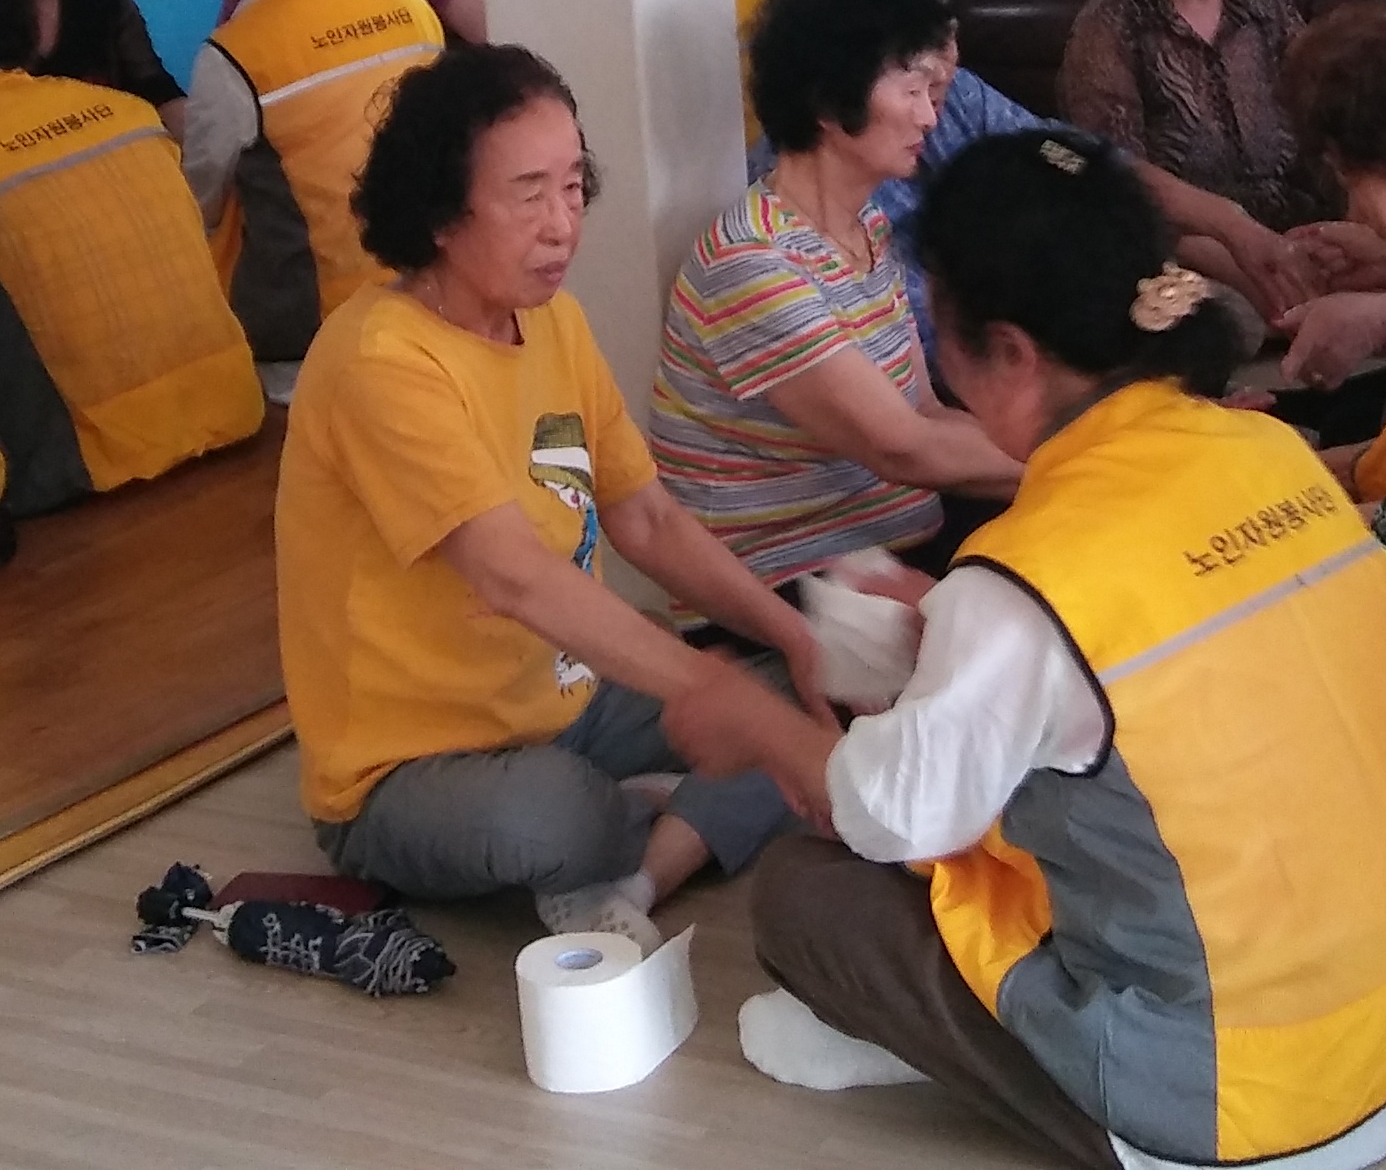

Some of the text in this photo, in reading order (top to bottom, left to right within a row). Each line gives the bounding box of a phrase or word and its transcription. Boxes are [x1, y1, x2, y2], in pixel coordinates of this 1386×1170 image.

[309, 6, 414, 50] 노인자원봉사단
[0, 102, 114, 153] 노인자원봉사단
[1182, 483, 1341, 577] 노인자원봉사단
